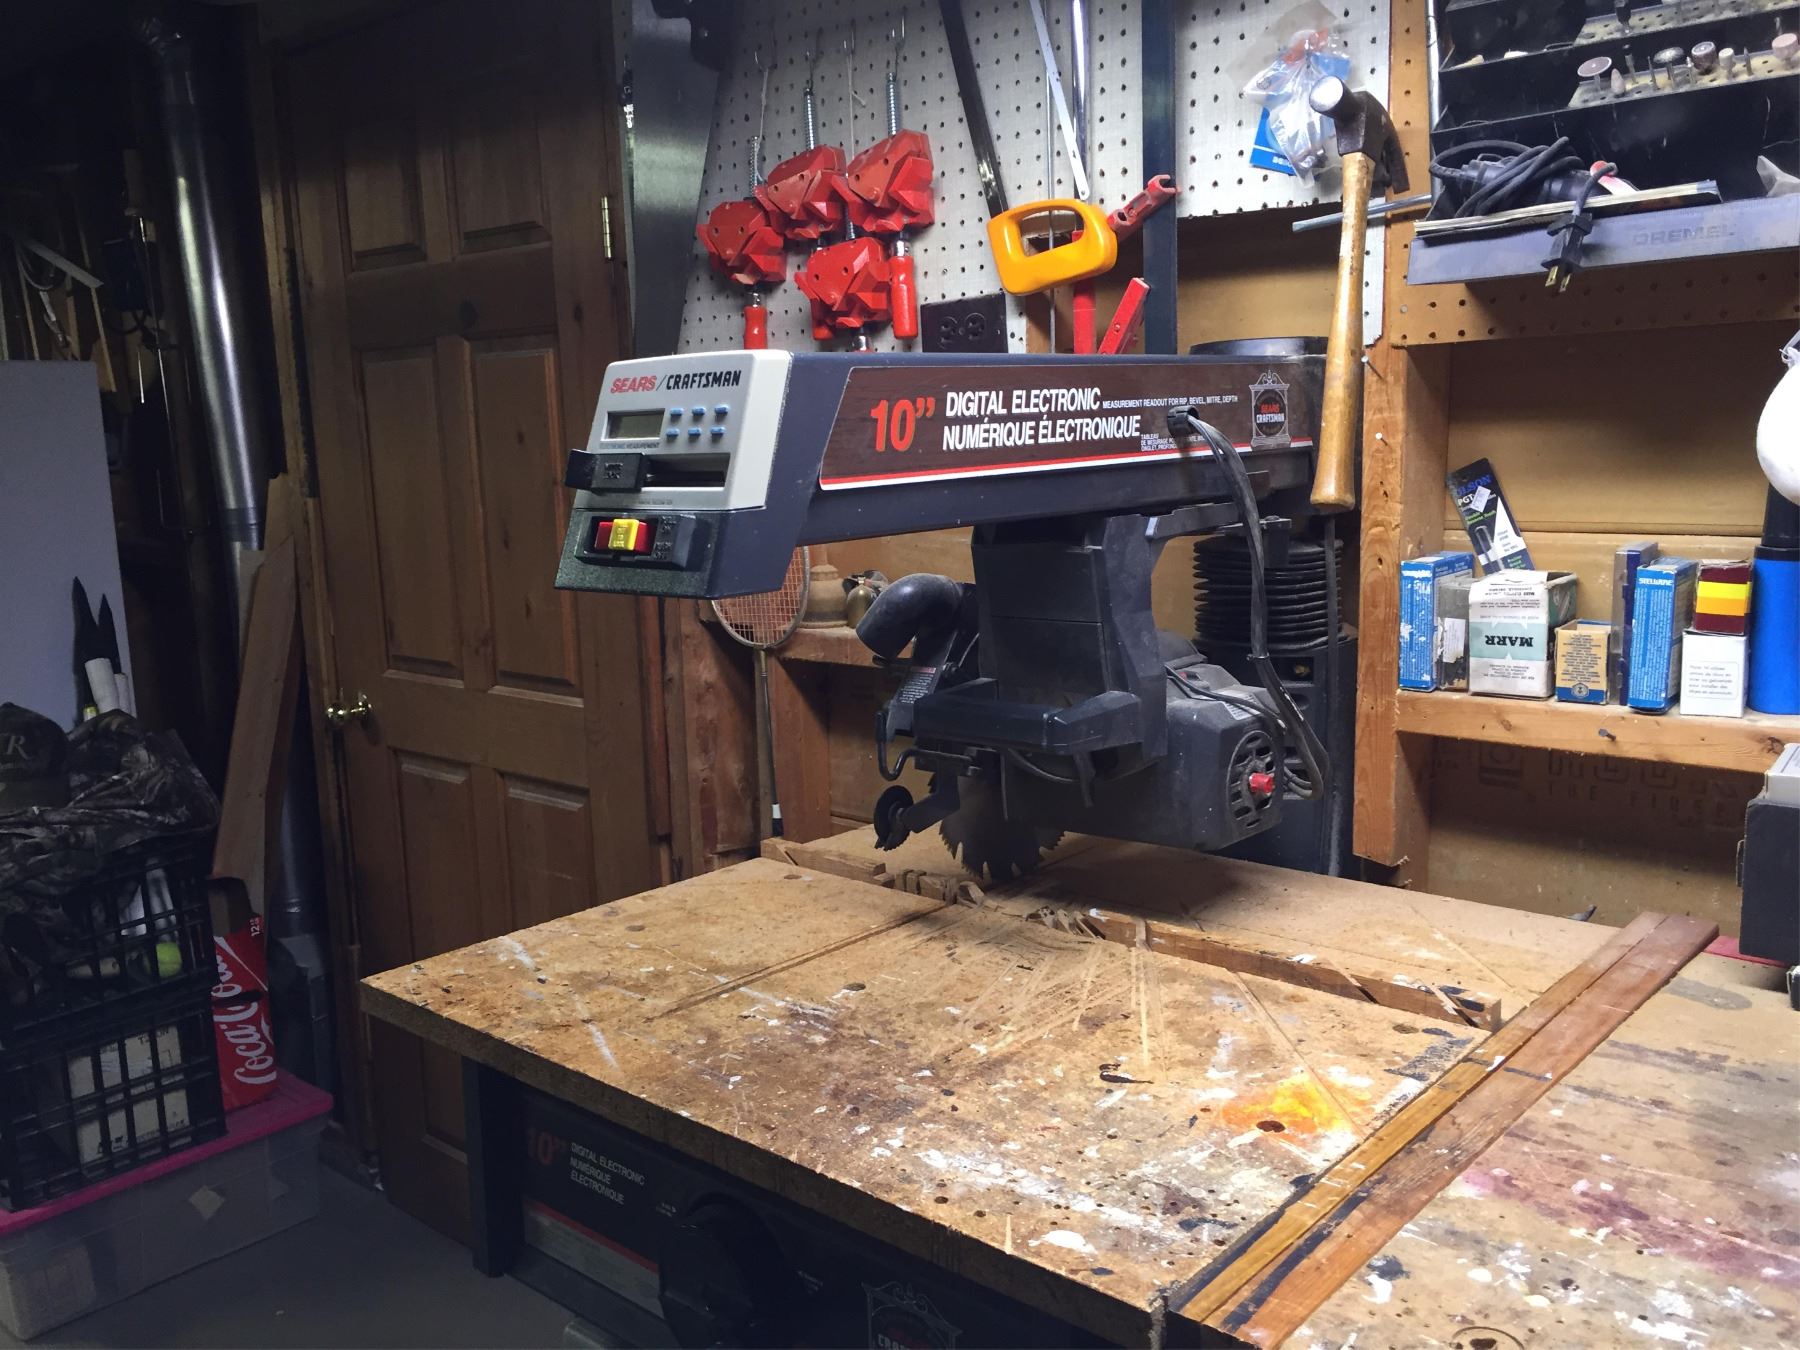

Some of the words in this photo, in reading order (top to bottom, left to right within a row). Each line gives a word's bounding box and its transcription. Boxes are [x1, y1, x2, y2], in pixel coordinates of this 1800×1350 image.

[945, 390, 1007, 418] DIGITAL
[1011, 387, 1101, 415] ELECTRONIC
[1102, 399, 1143, 409] MEASUREMENT
[1143, 397, 1168, 407] READOUT
[1168, 397, 1180, 406] FOR
[1189, 396, 1206, 405] BEVEL,
[942, 415, 1036, 451] NUMÉRIQUE
[1038, 411, 1142, 447] ÉLECTRONIQUE
[1484, 634, 1534, 648] MARR
[571, 1141, 599, 1164] DIGITAL
[599, 1153, 646, 1187] ELECTRONIC
